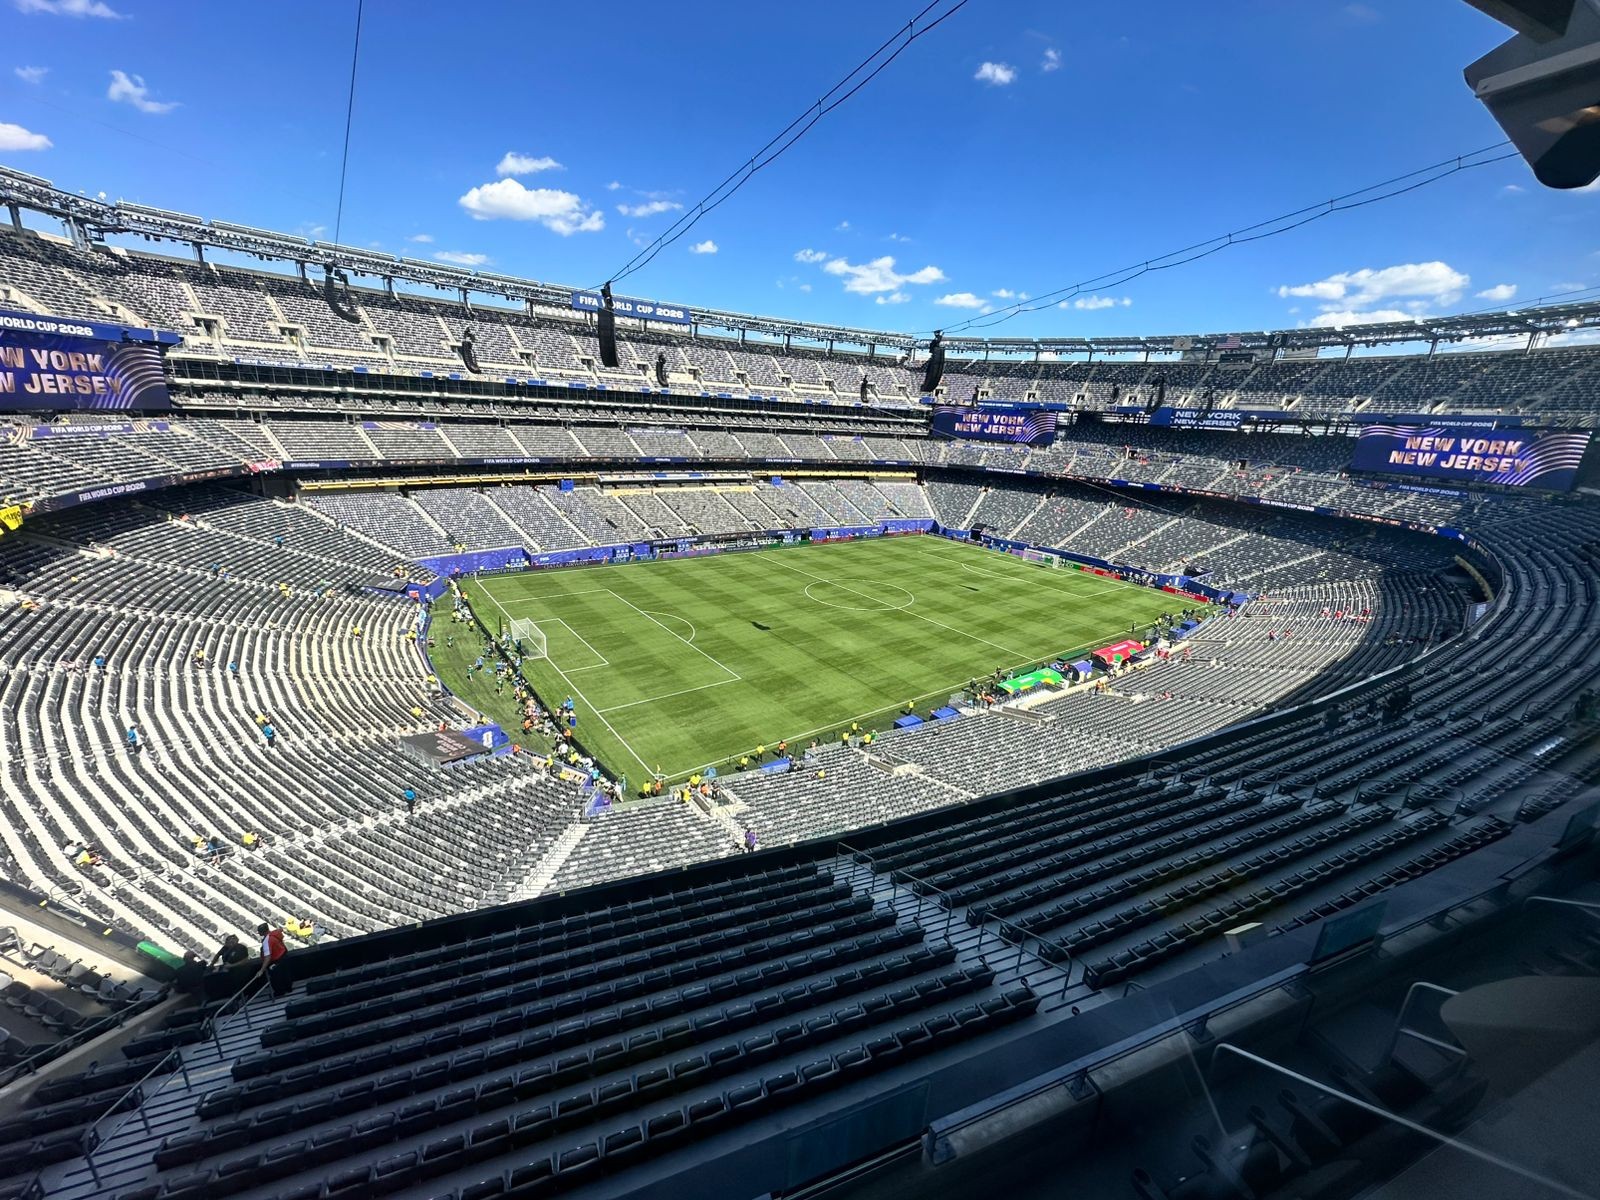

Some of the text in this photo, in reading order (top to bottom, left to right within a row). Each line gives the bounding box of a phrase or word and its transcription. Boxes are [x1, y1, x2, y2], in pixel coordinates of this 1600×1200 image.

[579, 295, 598, 306] FIFA
[636, 304, 653, 314] CUP
[656, 307, 684, 319] 2026
[36, 322, 58, 332] CUP
[58, 323, 94, 336] 2026
[30, 348, 105, 373] YORK
[24, 372, 123, 395] JERSEY
[962, 413, 1025, 426] NEW YORK
[1198, 419, 1240, 427] JERSEY
[954, 422, 1030, 436] NEW JERSEY
[1405, 436, 1523, 456] NEW YORK
[1389, 450, 1530, 473] NEW JERSEY
[113, 485, 125, 494] CUP
